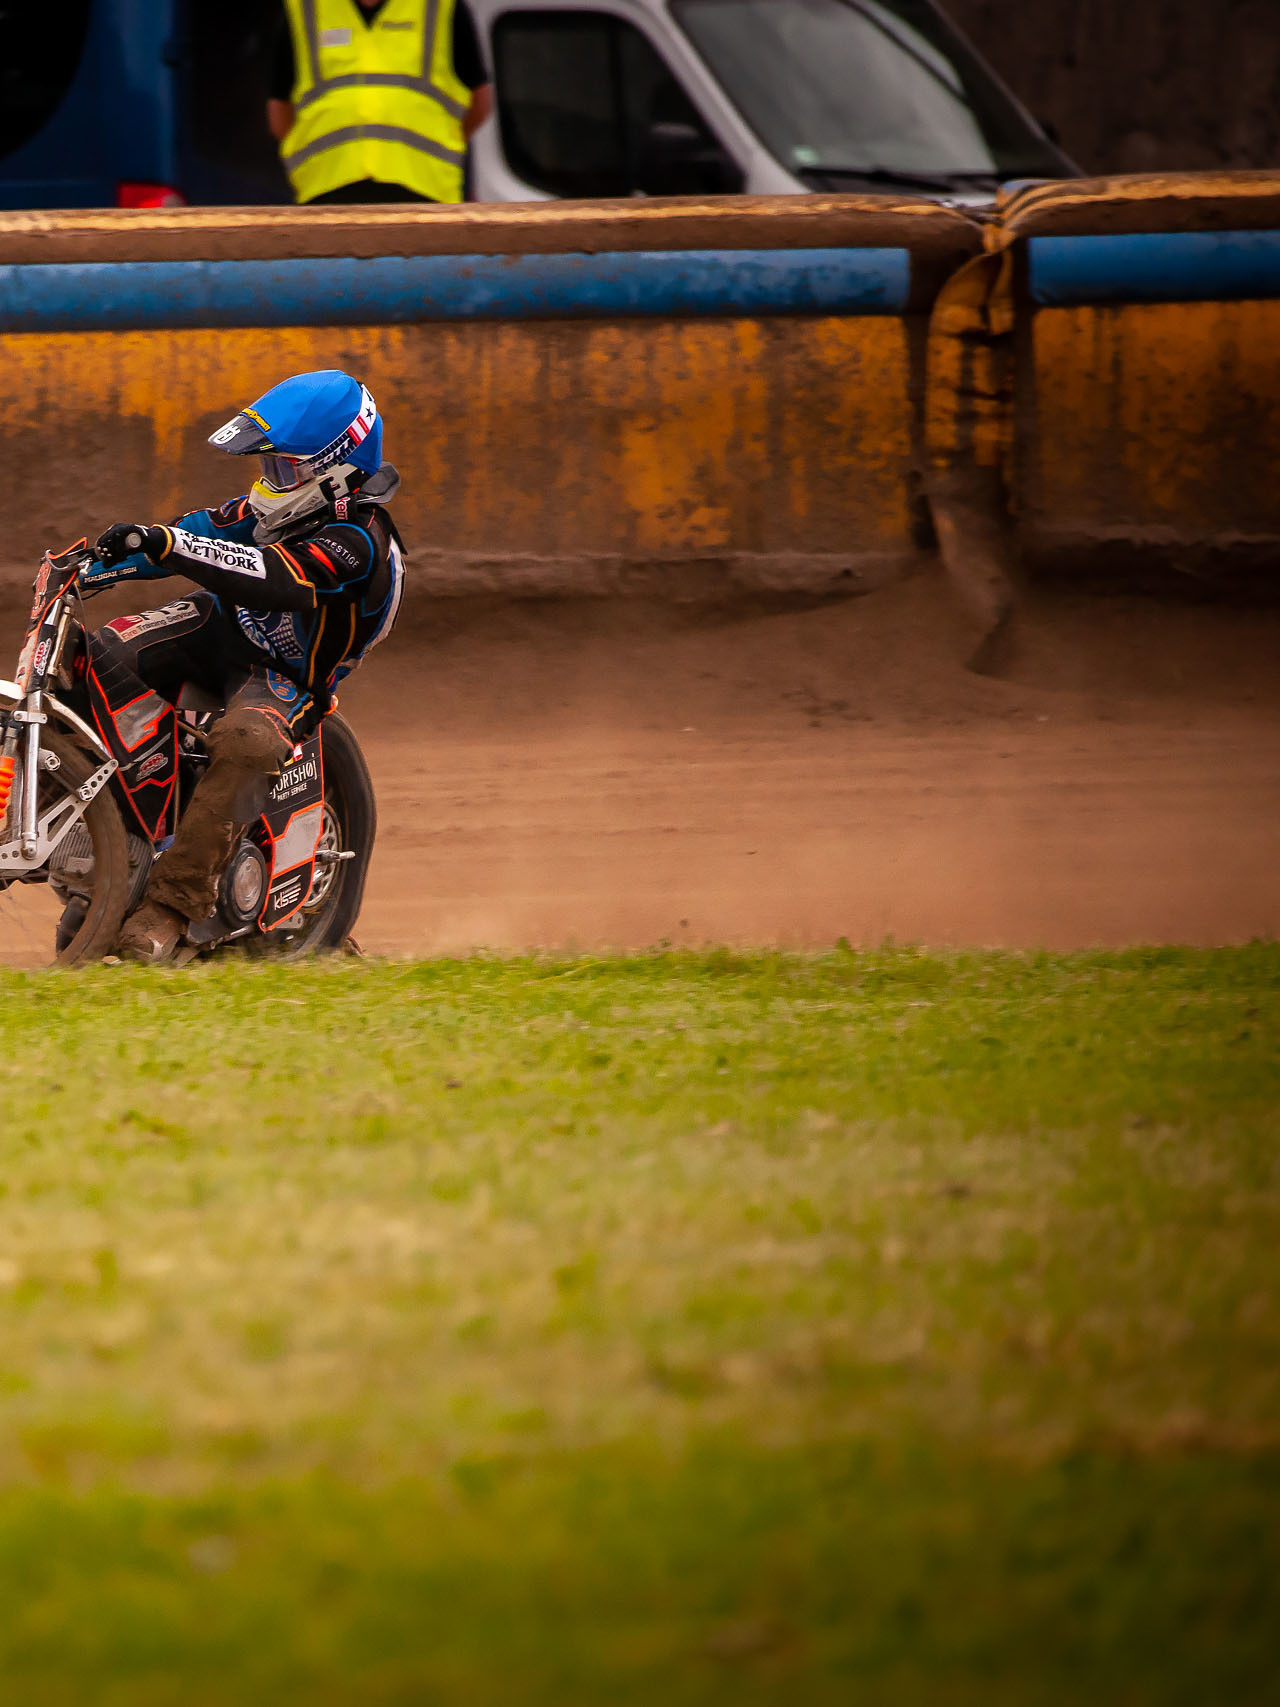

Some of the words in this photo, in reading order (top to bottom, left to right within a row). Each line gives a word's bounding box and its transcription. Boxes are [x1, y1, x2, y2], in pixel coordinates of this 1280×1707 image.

[182, 538, 259, 571] NETWORK
[121, 629, 138, 641] Fire
[137, 618, 167, 632] Training
[269, 752, 318, 799] JORTSHØJ
